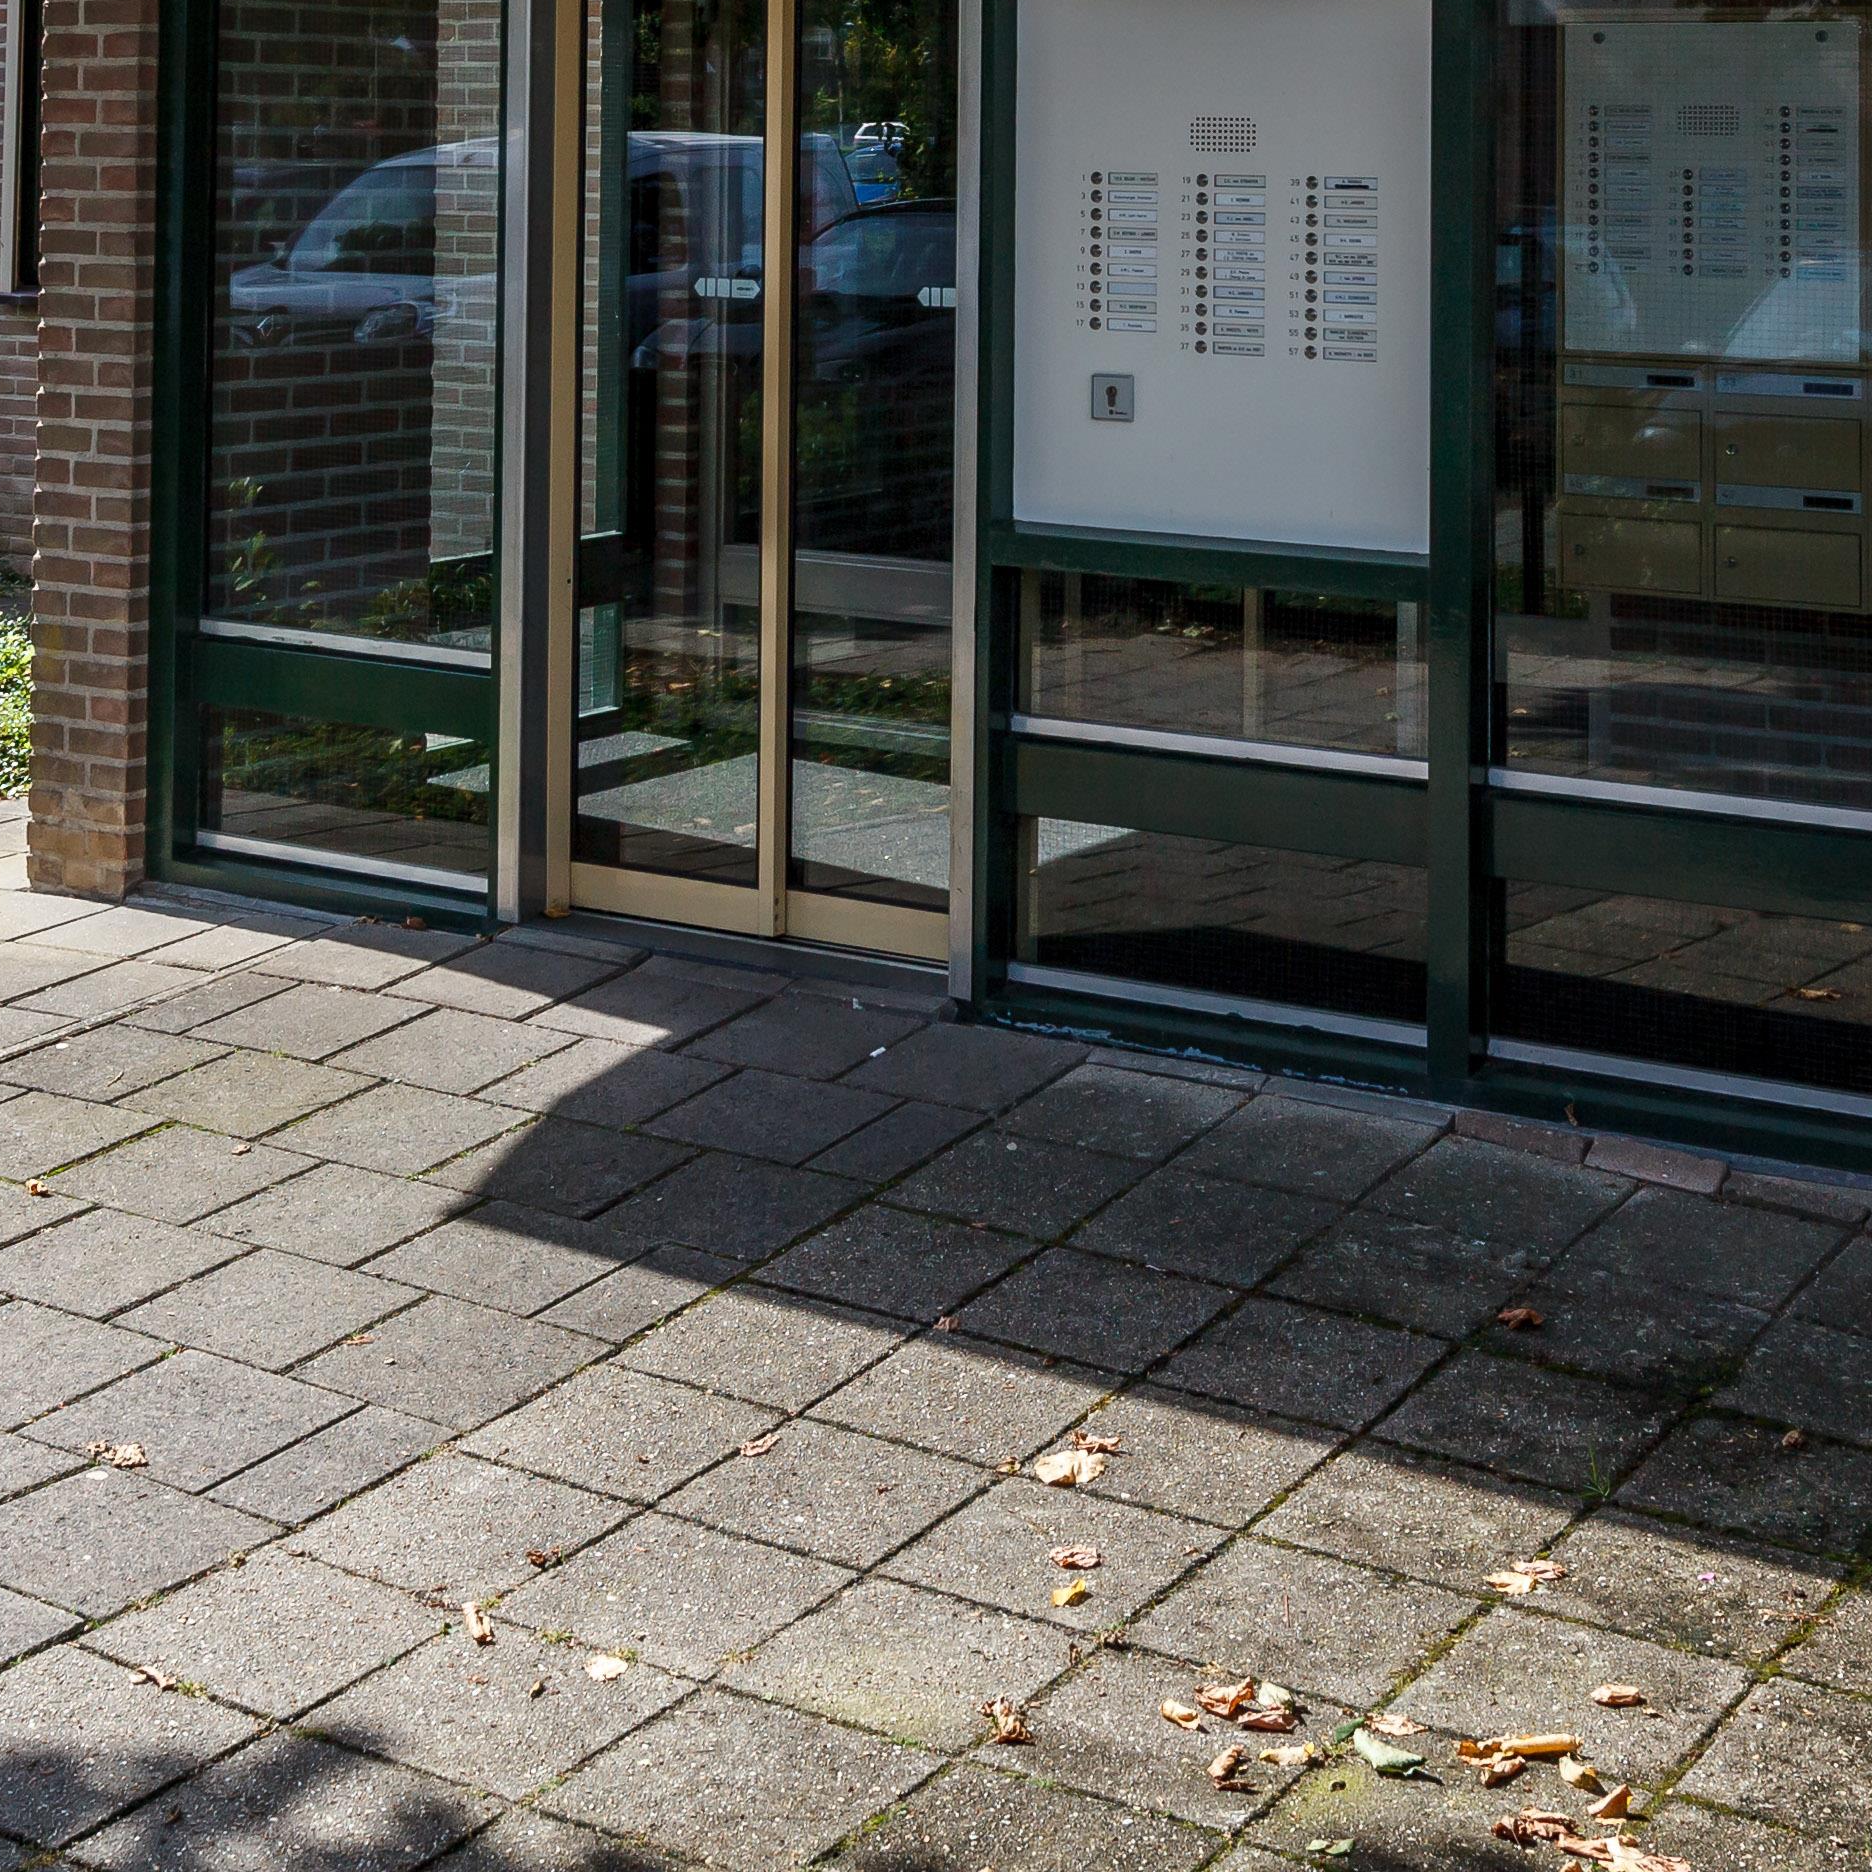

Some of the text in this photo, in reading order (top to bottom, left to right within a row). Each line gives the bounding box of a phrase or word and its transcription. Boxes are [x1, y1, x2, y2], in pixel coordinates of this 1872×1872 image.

[1181, 305, 1189, 313] 33
[1289, 310, 1299, 318] 53
[1181, 342, 1189, 350] 37
